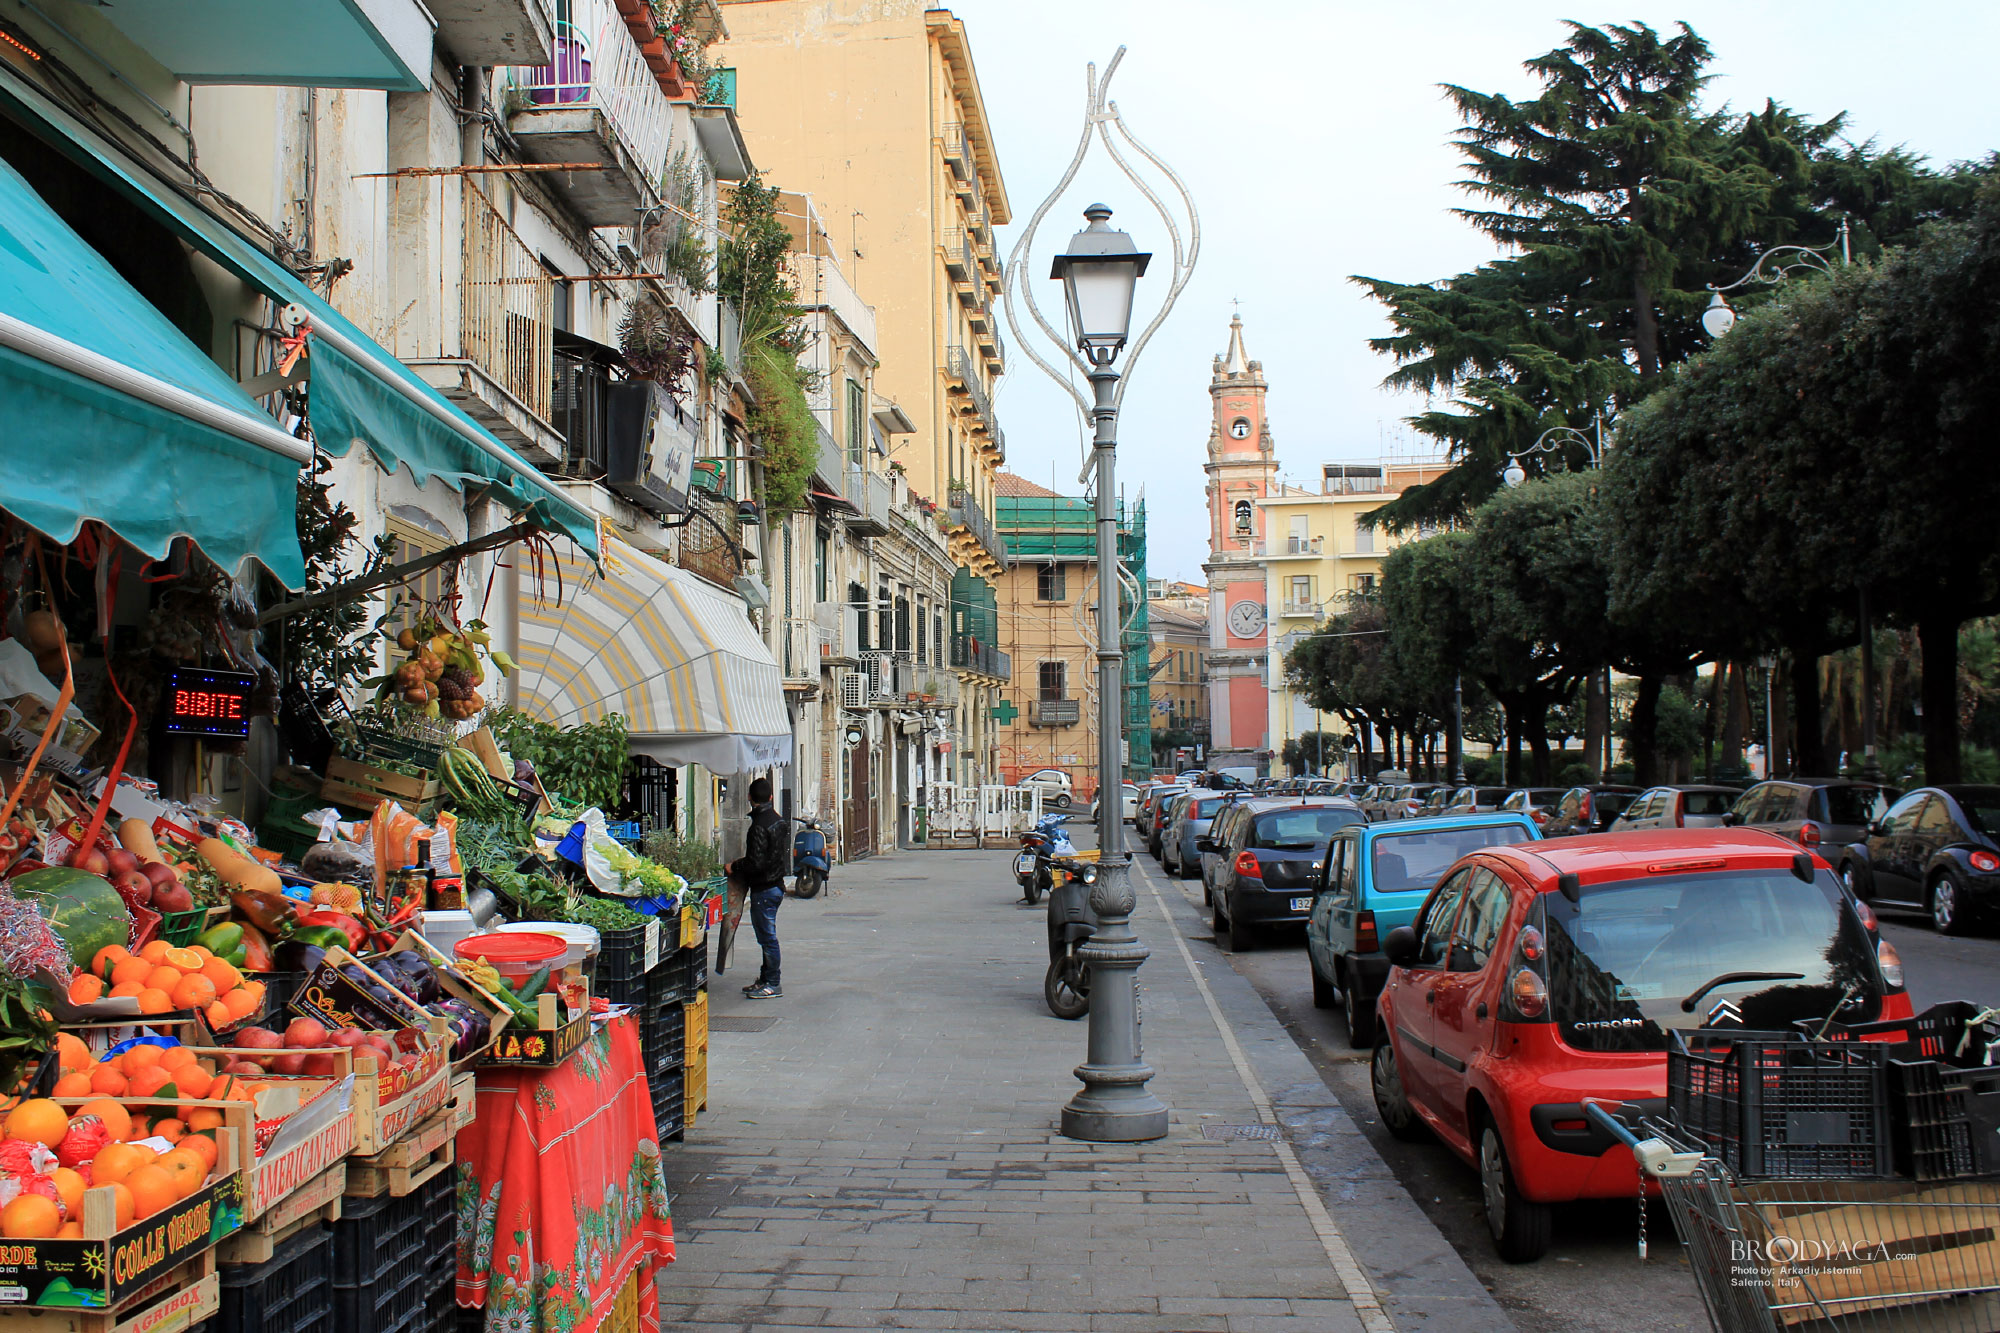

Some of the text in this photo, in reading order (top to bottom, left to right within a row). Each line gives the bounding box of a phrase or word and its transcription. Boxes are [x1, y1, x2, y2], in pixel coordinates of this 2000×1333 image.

[175, 690, 243, 719] BIBITE
[323, 1112, 356, 1166] FRUIT
[255, 1130, 323, 1210] AMERICAN
[114, 1200, 212, 1285] COLLE VERDE
[132, 1285, 201, 1333] AGRIBOX
